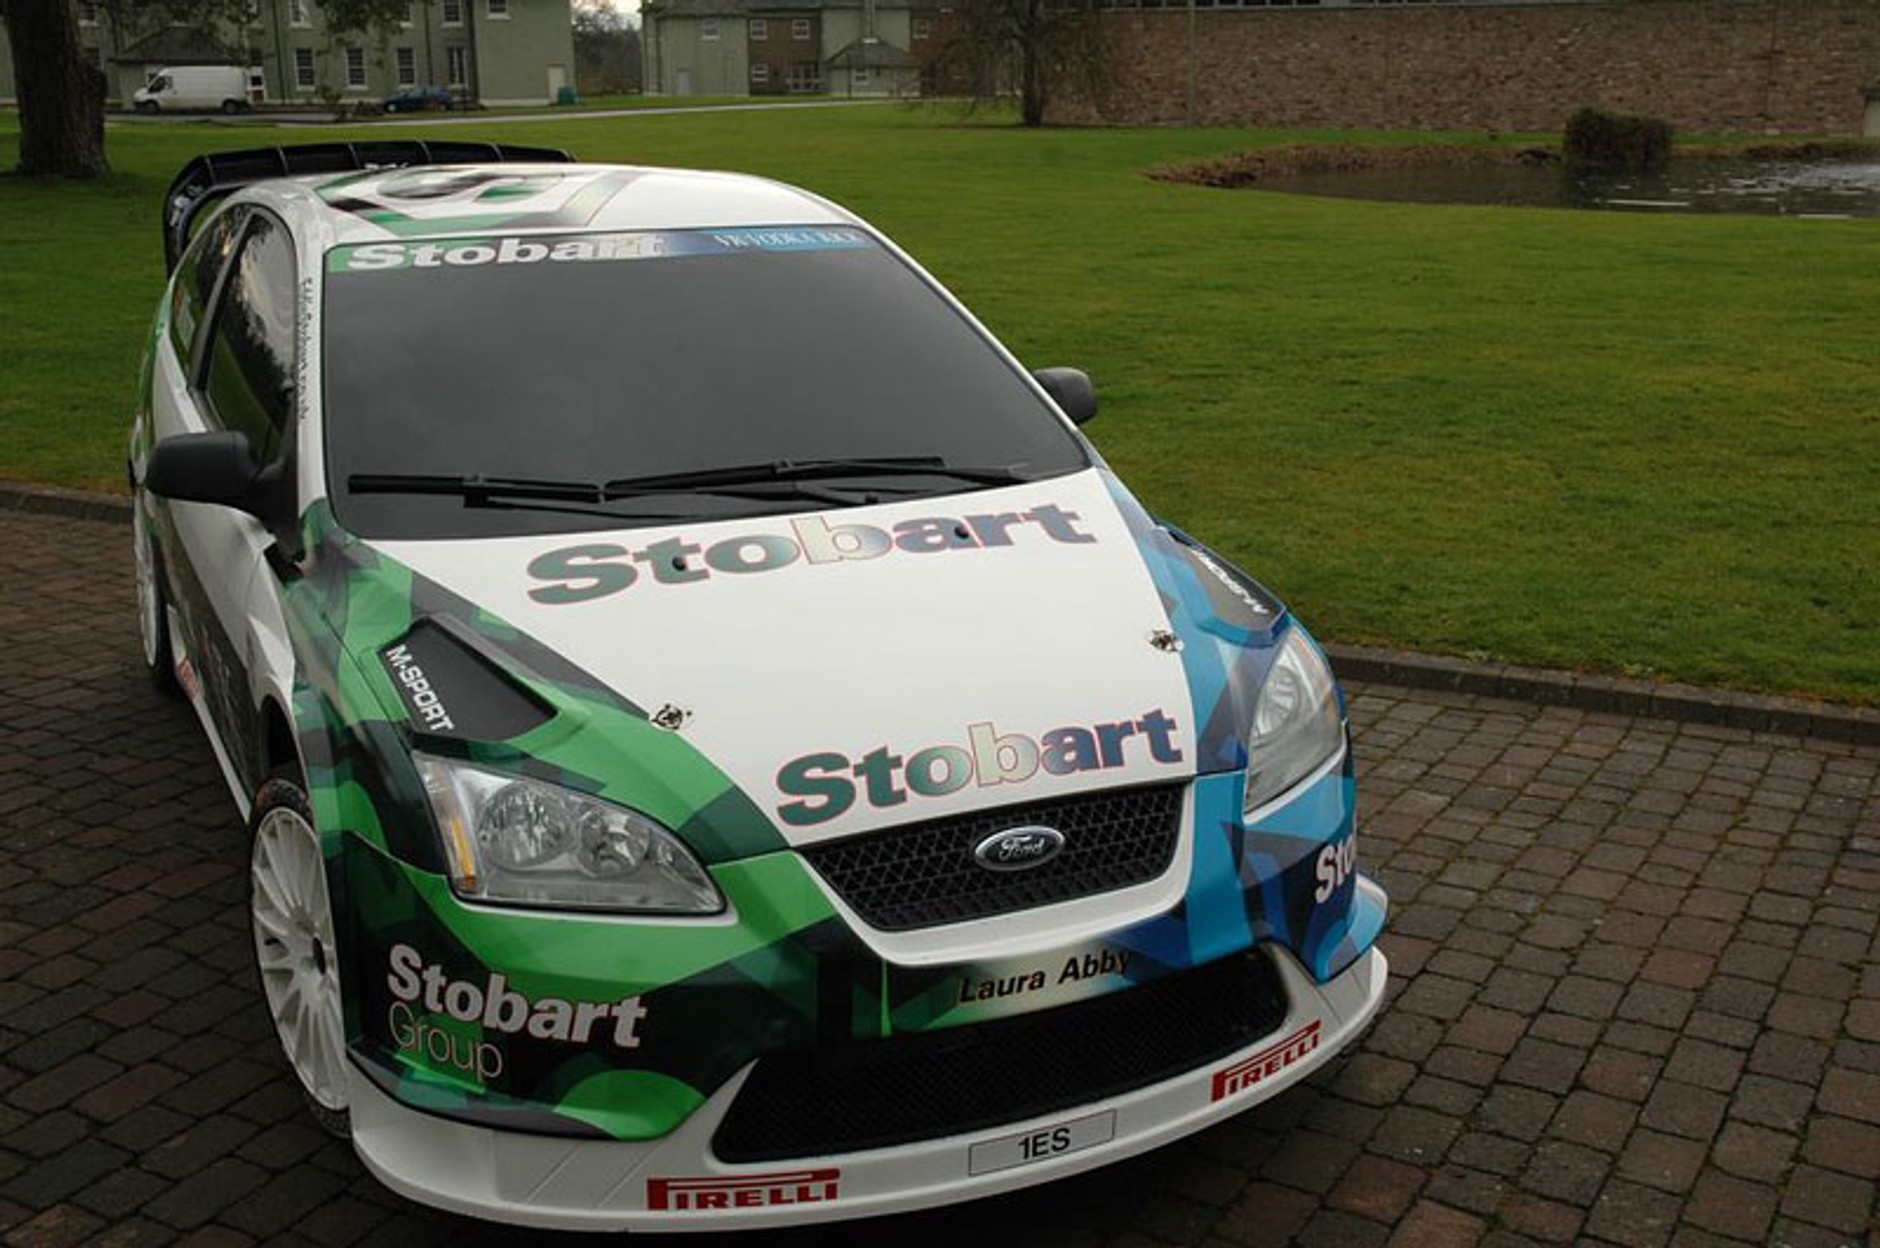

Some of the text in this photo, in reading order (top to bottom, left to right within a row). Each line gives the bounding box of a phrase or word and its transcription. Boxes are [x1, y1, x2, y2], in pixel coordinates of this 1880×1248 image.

[347, 231, 665, 270] Stobart
[526, 503, 1097, 605] Stobart
[385, 643, 455, 731] M-SPORT
[775, 708, 1183, 828] Stobart
[999, 833, 1045, 861] Ford
[387, 943, 648, 1048] Stobart
[959, 950, 1132, 1003] Laura Abby
[388, 1001, 503, 1083] Group
[1211, 1019, 1322, 1104] PIRELLI
[1017, 1127, 1071, 1160] 1ES
[647, 1168, 840, 1211] PIRELLI
